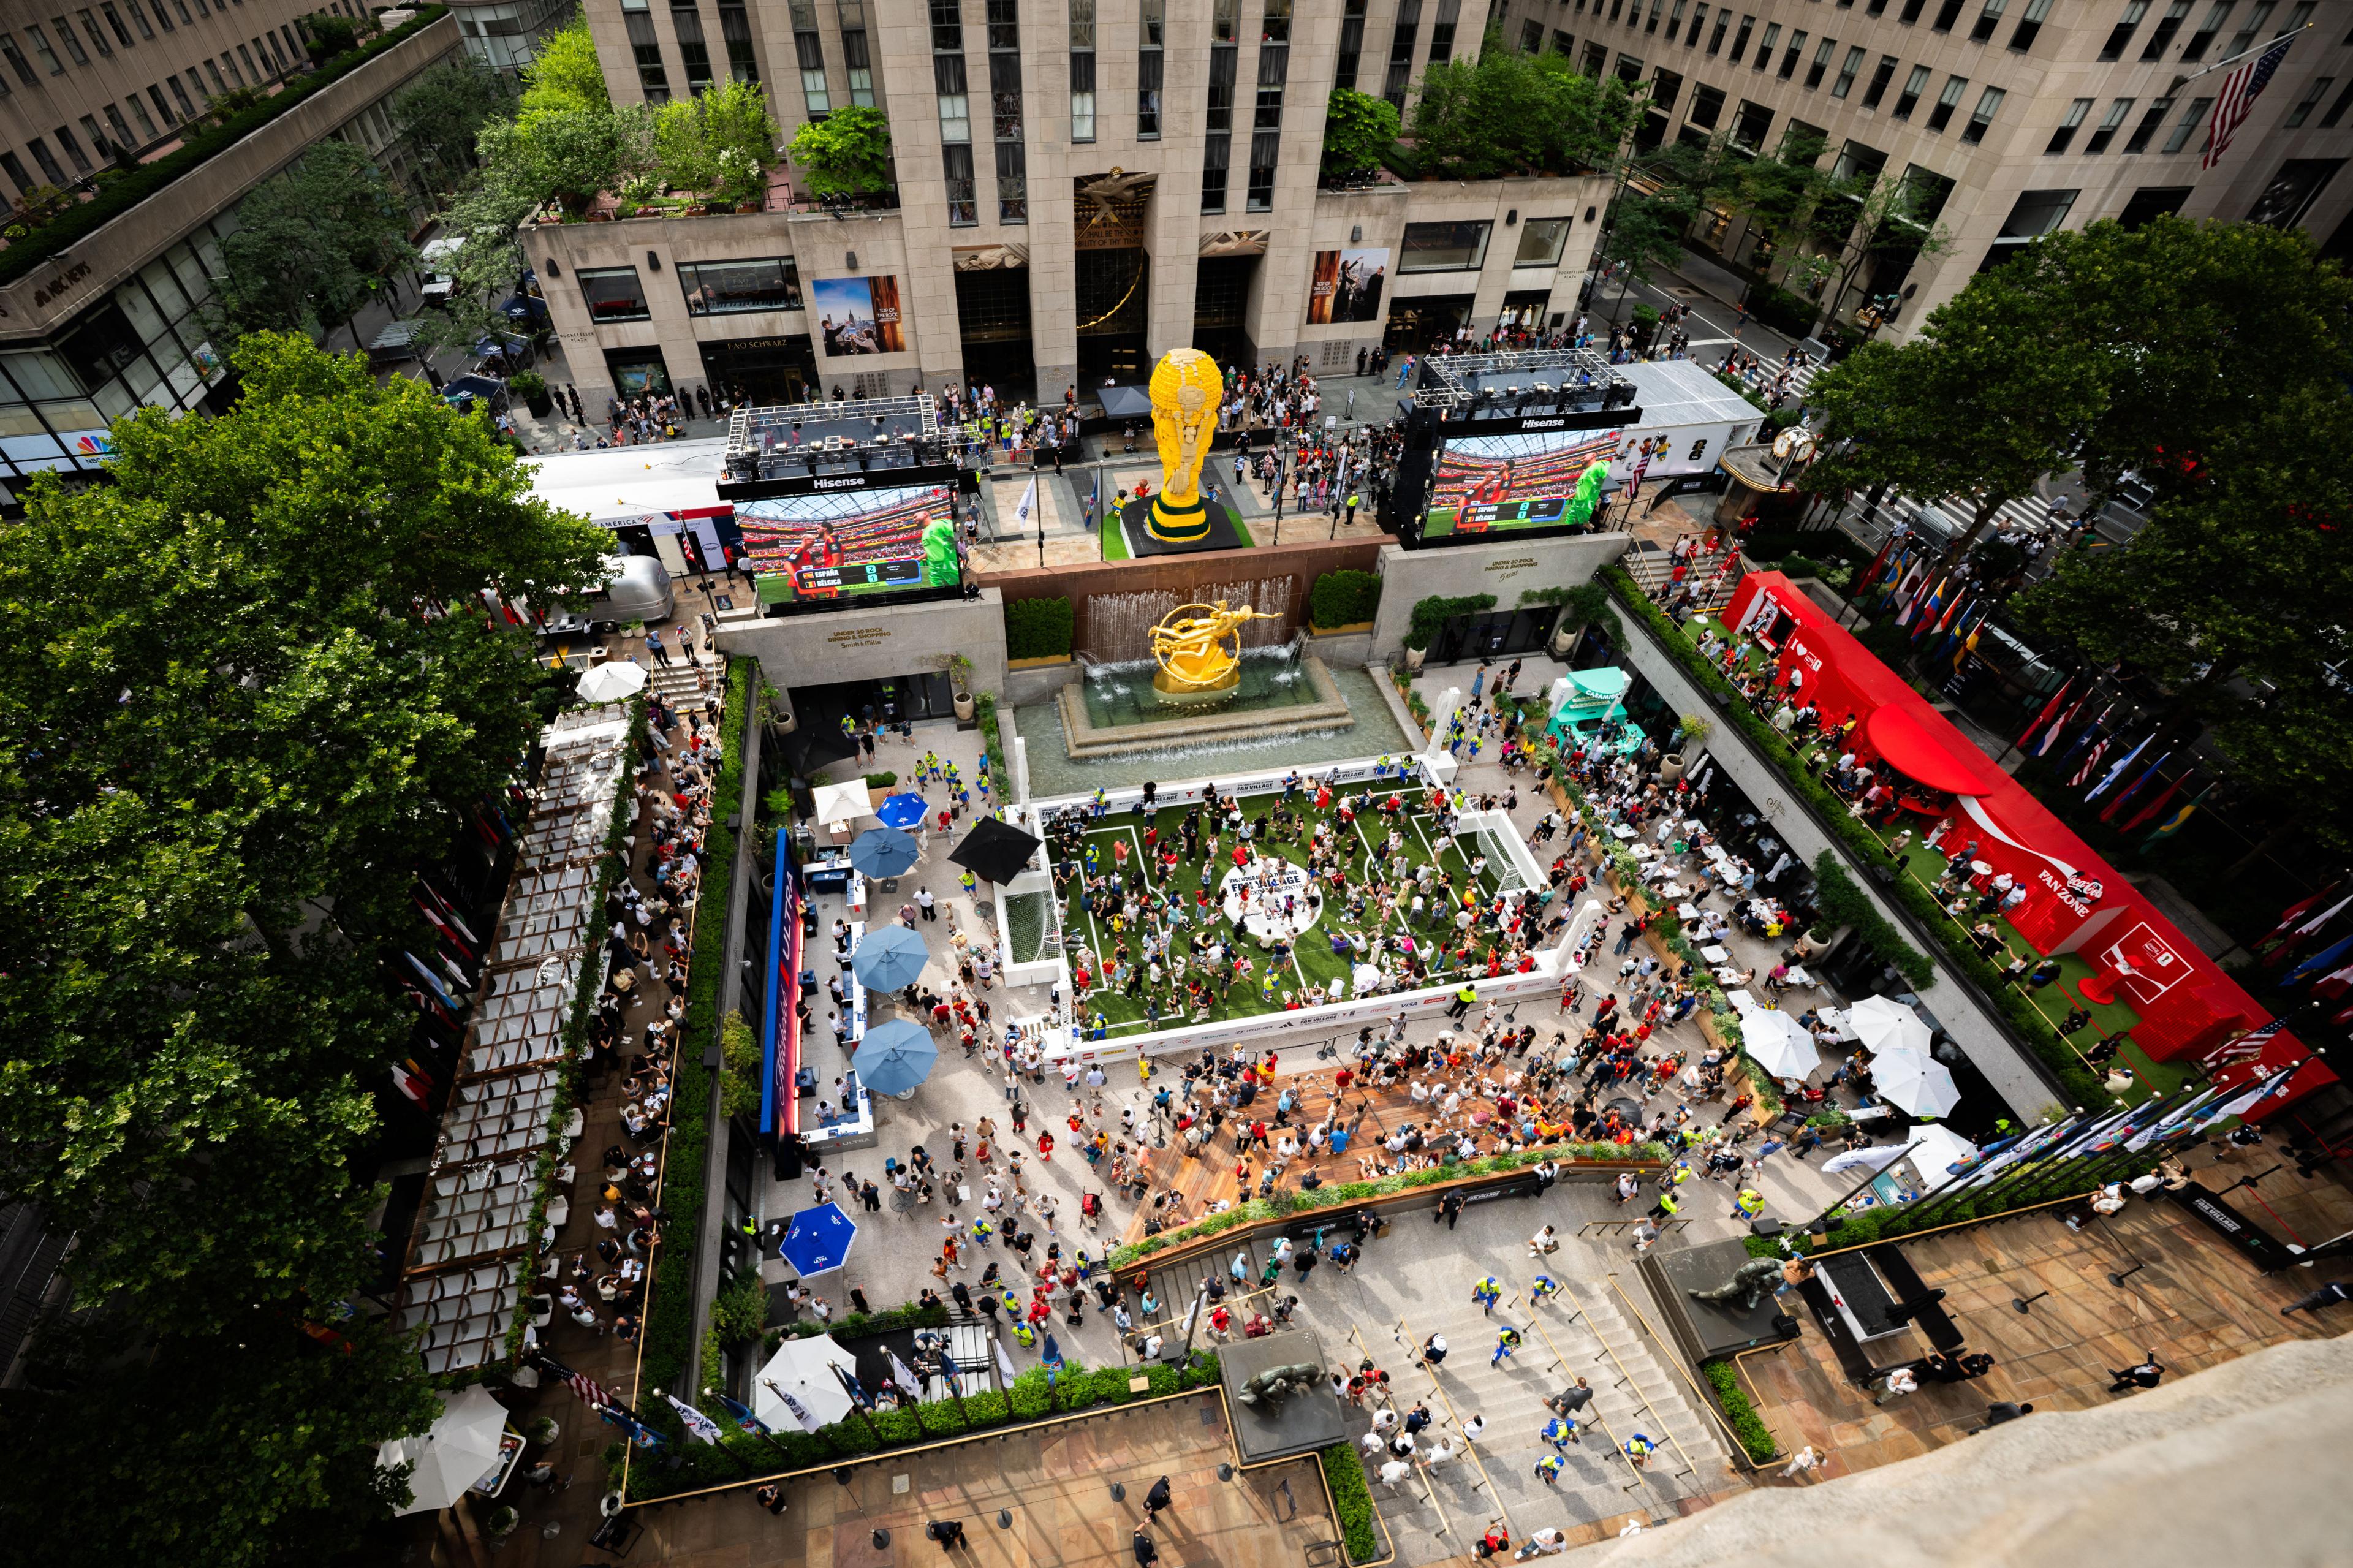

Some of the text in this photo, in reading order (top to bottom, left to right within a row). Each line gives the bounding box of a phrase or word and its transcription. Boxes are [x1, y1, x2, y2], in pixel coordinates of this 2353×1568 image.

[46, 260, 91, 298] NBC NEWS
[749, 339, 787, 349] SCHWARZ
[1521, 419, 1564, 428] Hisense
[813, 477, 865, 489] Hisense
[600, 519, 637, 528] AMERICA
[815, 568, 839, 578] ESPAÑA
[1499, 573, 1506, 583] 5
[817, 578, 842, 587] BÉLGICA
[2067, 875, 2103, 898] Coca-Cola
[2038, 869, 2090, 918] FAN ZONE
[782, 871, 793, 960] ULTRA
[2194, 1199, 2238, 1231] FAN VILLAGE
